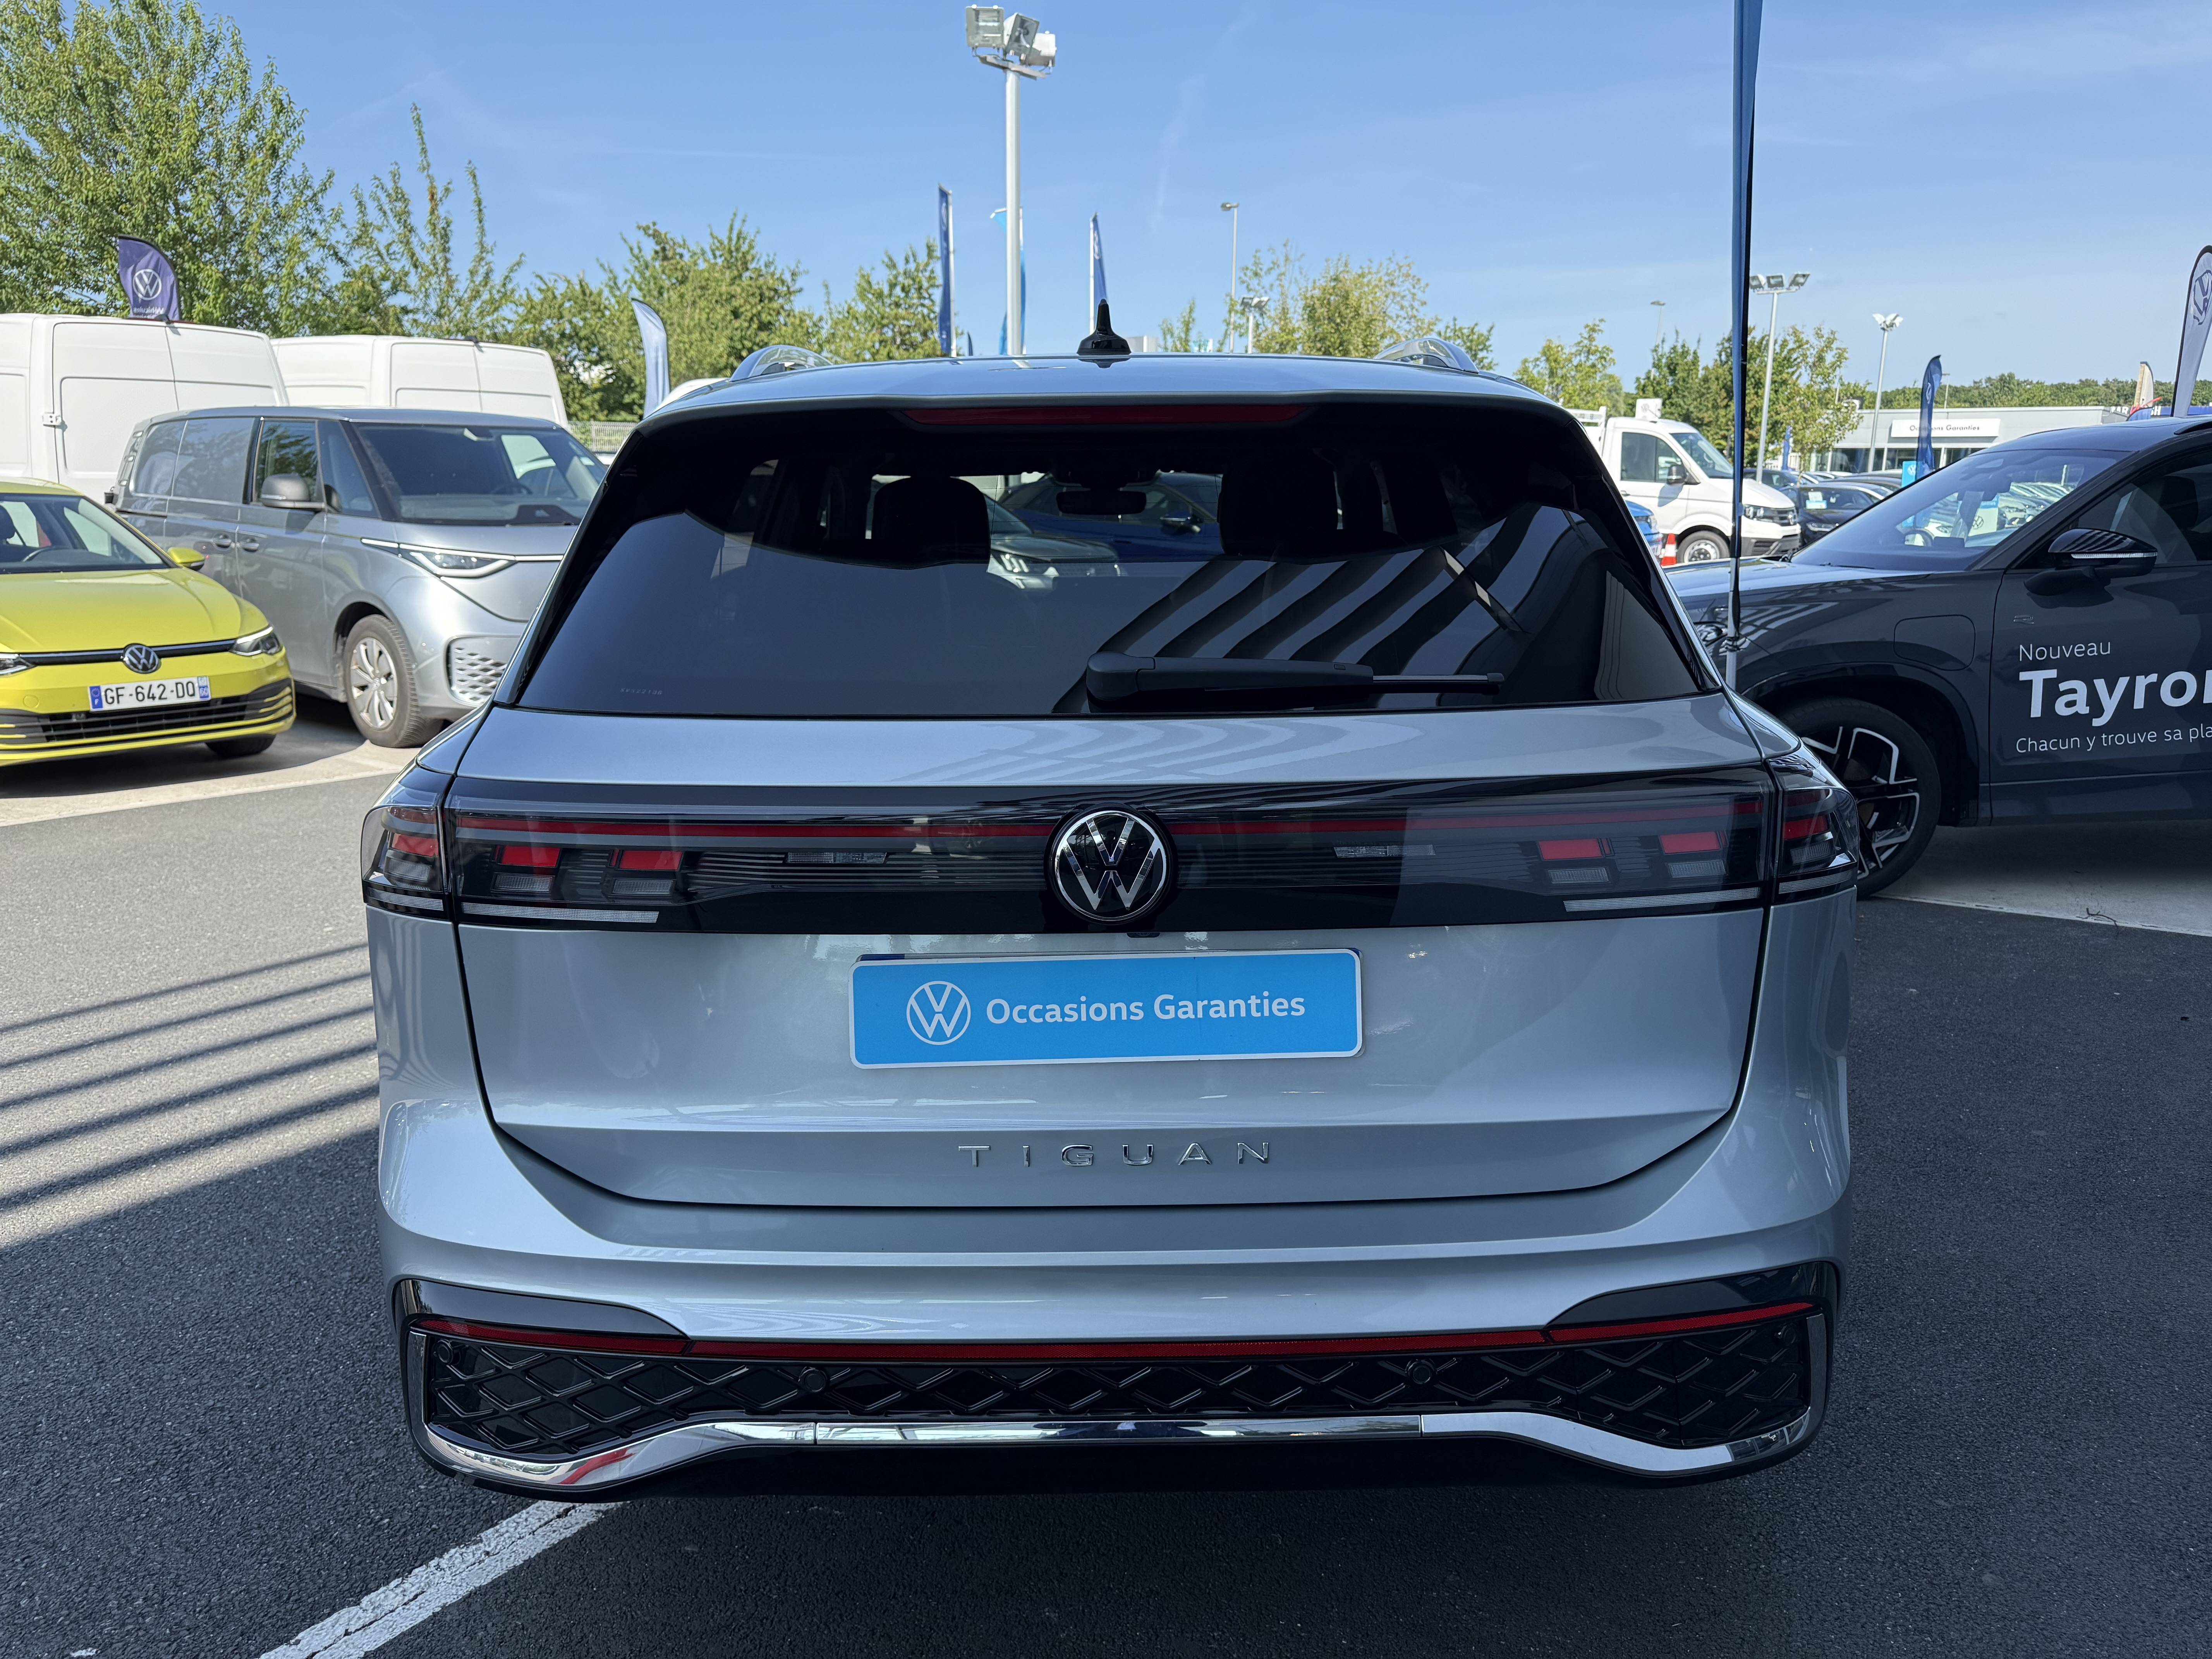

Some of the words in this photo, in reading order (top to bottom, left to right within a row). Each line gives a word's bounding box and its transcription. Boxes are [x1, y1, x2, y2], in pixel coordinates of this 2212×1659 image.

[2019, 641, 2111, 661] Nouveau
[2019, 669, 2212, 727] Tayro
[2016, 736, 2080, 753] Chacun
[2087, 736, 2096, 752] y
[2101, 730, 2157, 746] trouve
[2164, 729, 2183, 742] sa
[1054, 810, 1167, 921] VW
[986, 996, 1144, 1025] Occasions
[1154, 991, 1305, 1020] Garanties
[958, 1142, 1270, 1167] TIGUAN
